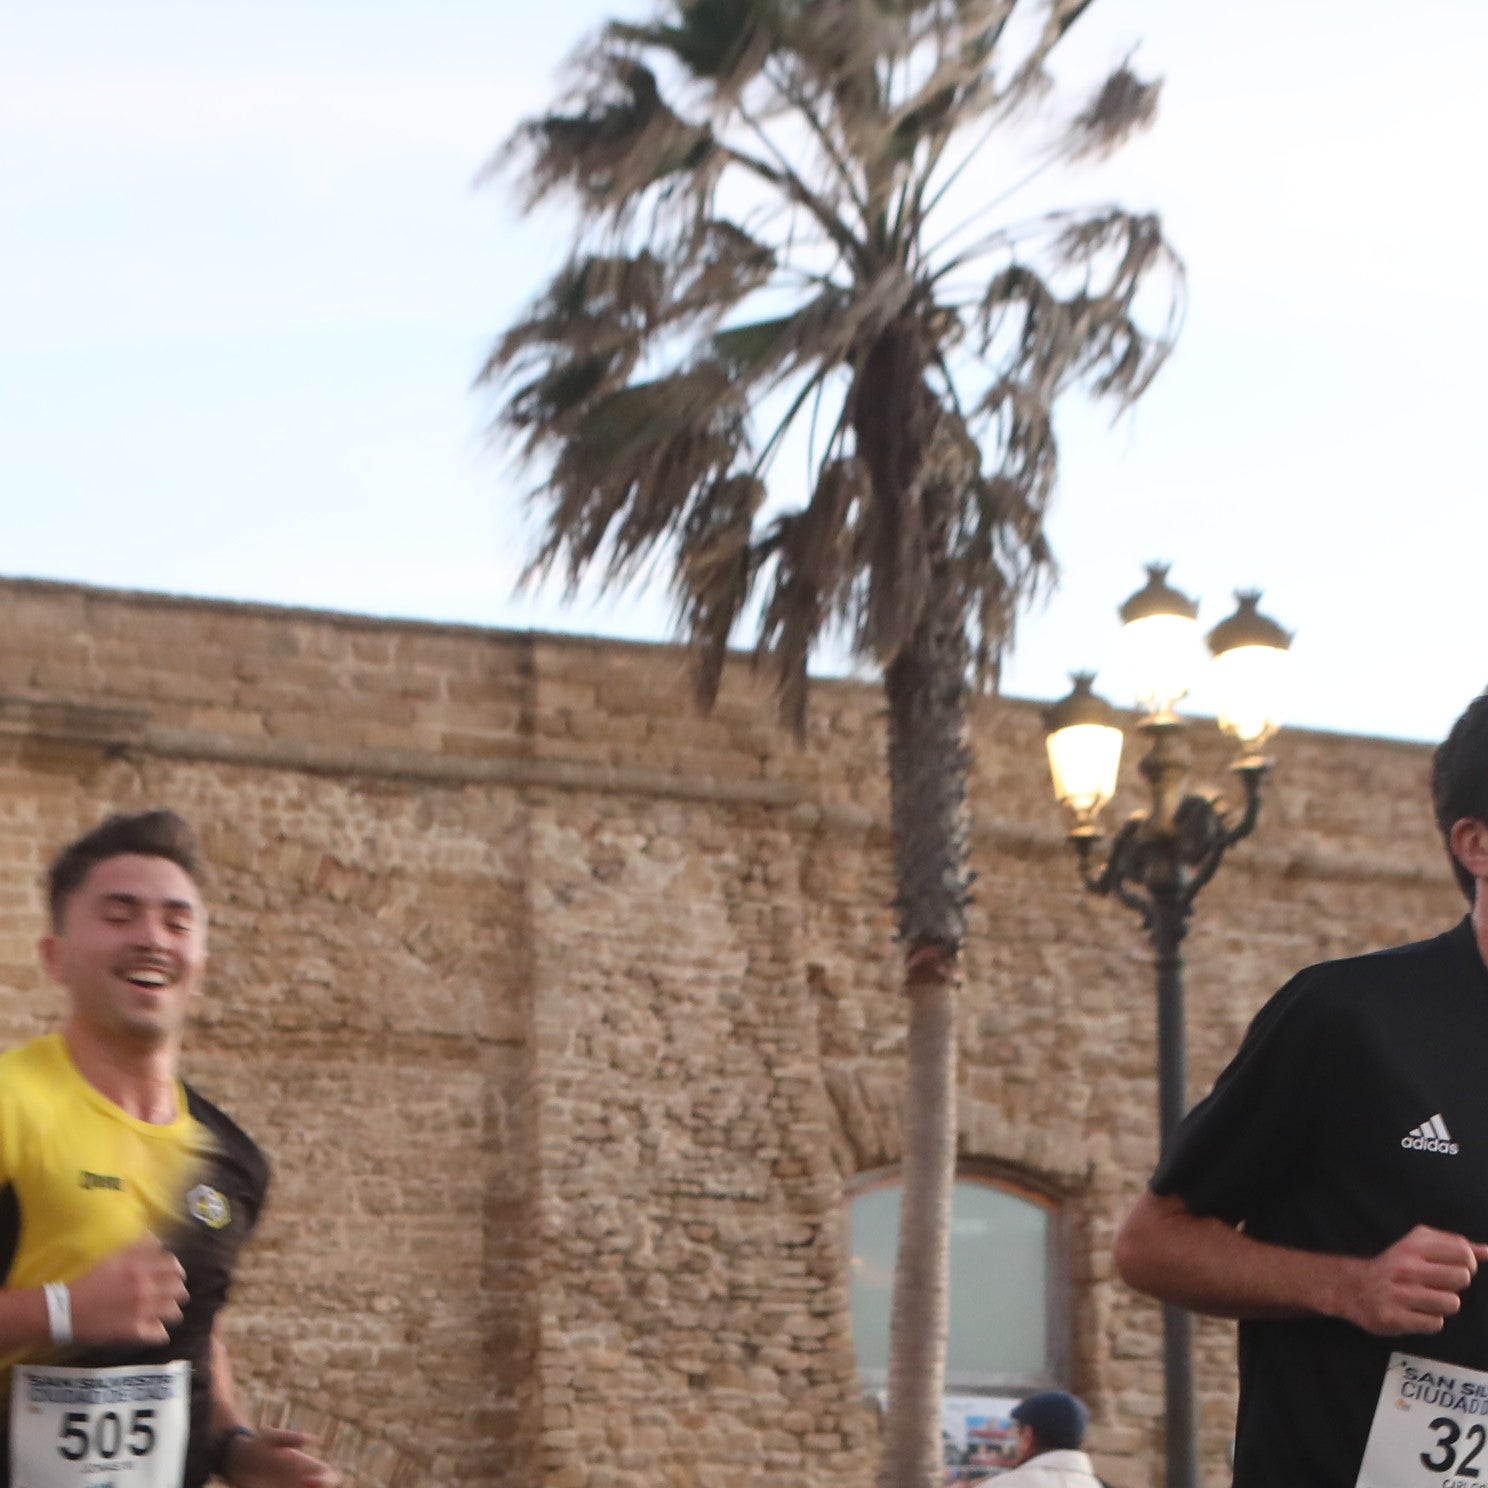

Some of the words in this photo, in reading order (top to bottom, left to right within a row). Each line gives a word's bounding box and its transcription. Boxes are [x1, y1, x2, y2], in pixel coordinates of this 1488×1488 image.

[1401, 1136, 1459, 1155] adidas
[1404, 1368, 1455, 1389] SAN
[1401, 1381, 1478, 1414] CIUDAD
[59, 1409, 155, 1460] 505
